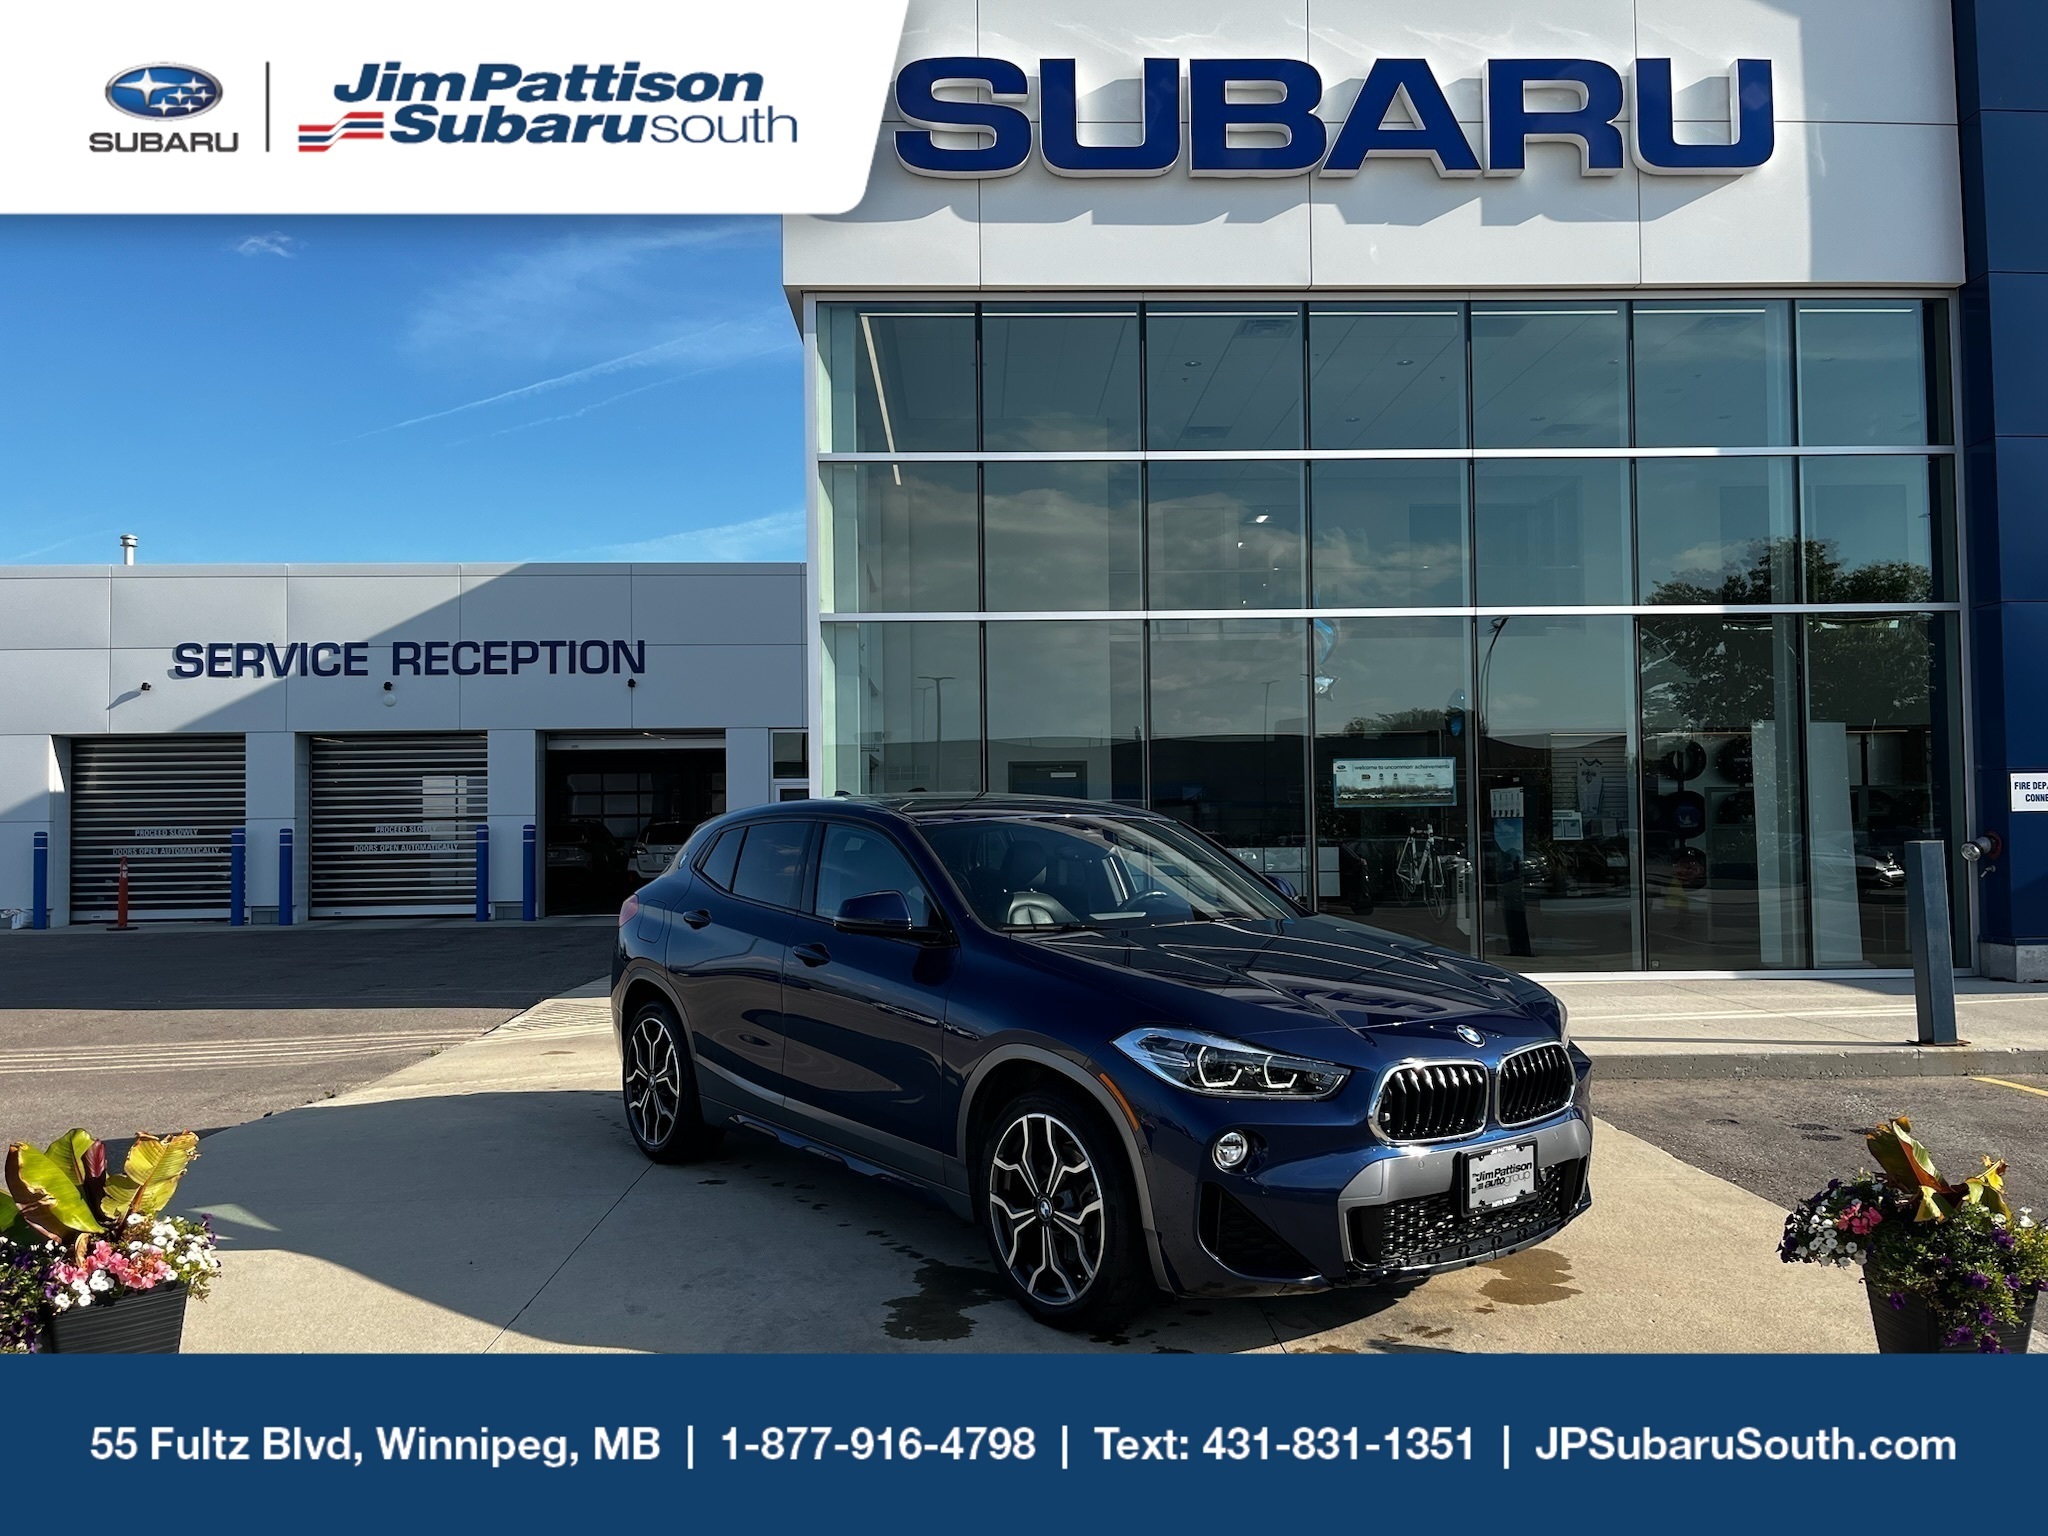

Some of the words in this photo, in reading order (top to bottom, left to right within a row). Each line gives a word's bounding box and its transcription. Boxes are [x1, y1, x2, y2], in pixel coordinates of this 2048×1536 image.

[894, 57, 1775, 180] SUBARU
[173, 641, 369, 678] SERVICE
[391, 639, 646, 676] RECEPTION
[1354, 763, 1378, 771] welcome
[2014, 781, 2031, 790] FIRE
[2032, 781, 2048, 790] DEP
[134, 828, 168, 837] PROCEED
[169, 828, 199, 836] SLOWLY
[375, 825, 408, 834] PROCEED
[408, 825, 438, 833] SLOWLY
[112, 847, 138, 856] DOORS
[138, 847, 160, 855] OPEN
[353, 844, 379, 852] DOORS
[379, 844, 401, 852] OPEN
[401, 843, 460, 852] AUTOMATICALLY
